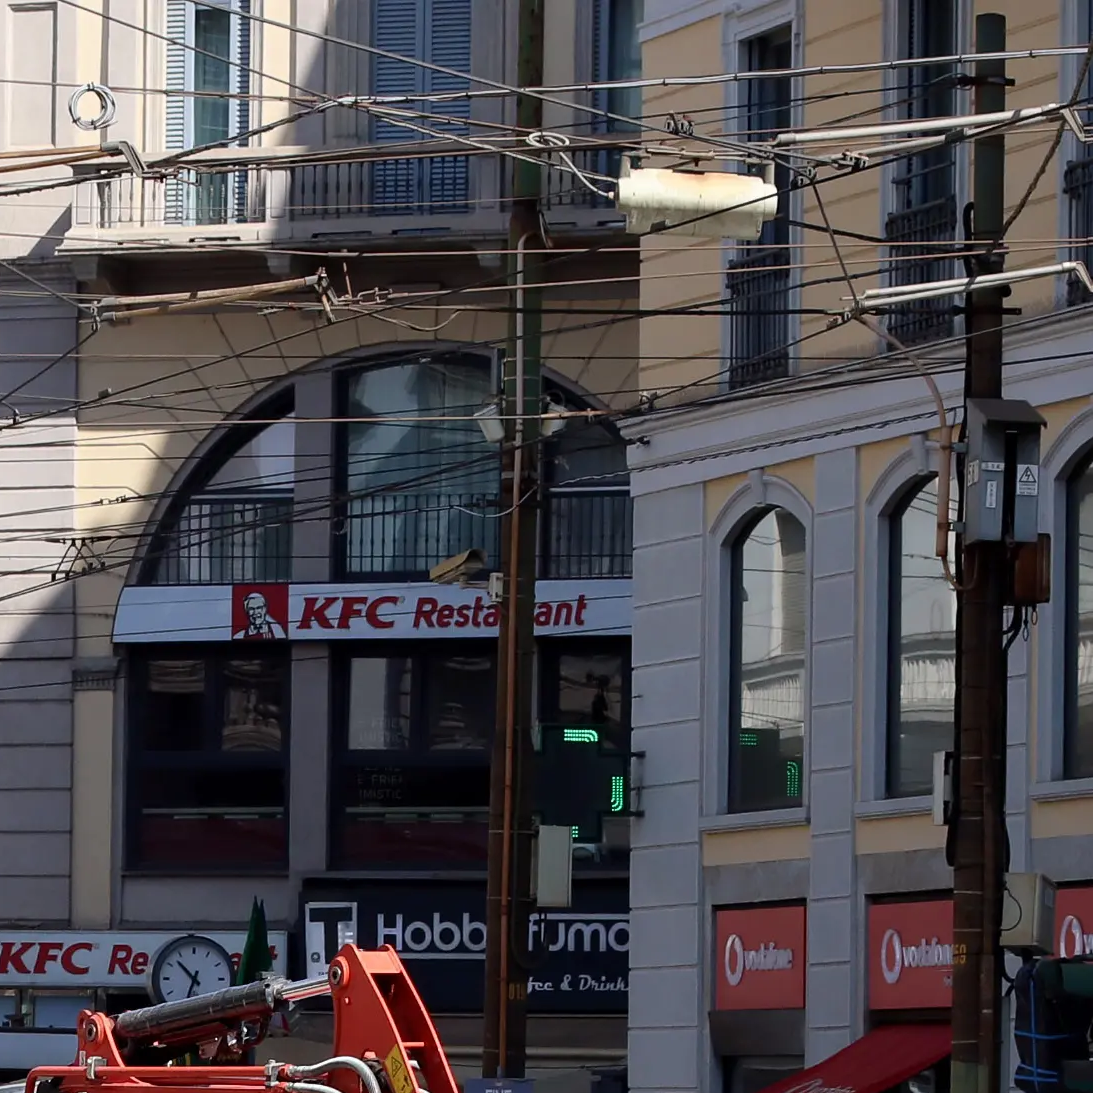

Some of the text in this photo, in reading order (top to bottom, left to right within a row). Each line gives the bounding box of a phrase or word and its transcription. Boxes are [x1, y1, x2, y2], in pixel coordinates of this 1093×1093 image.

[296, 595, 588, 631] KFC Restaant
[377, 911, 487, 952] Hobb
[902, 936, 954, 968] vodafon
